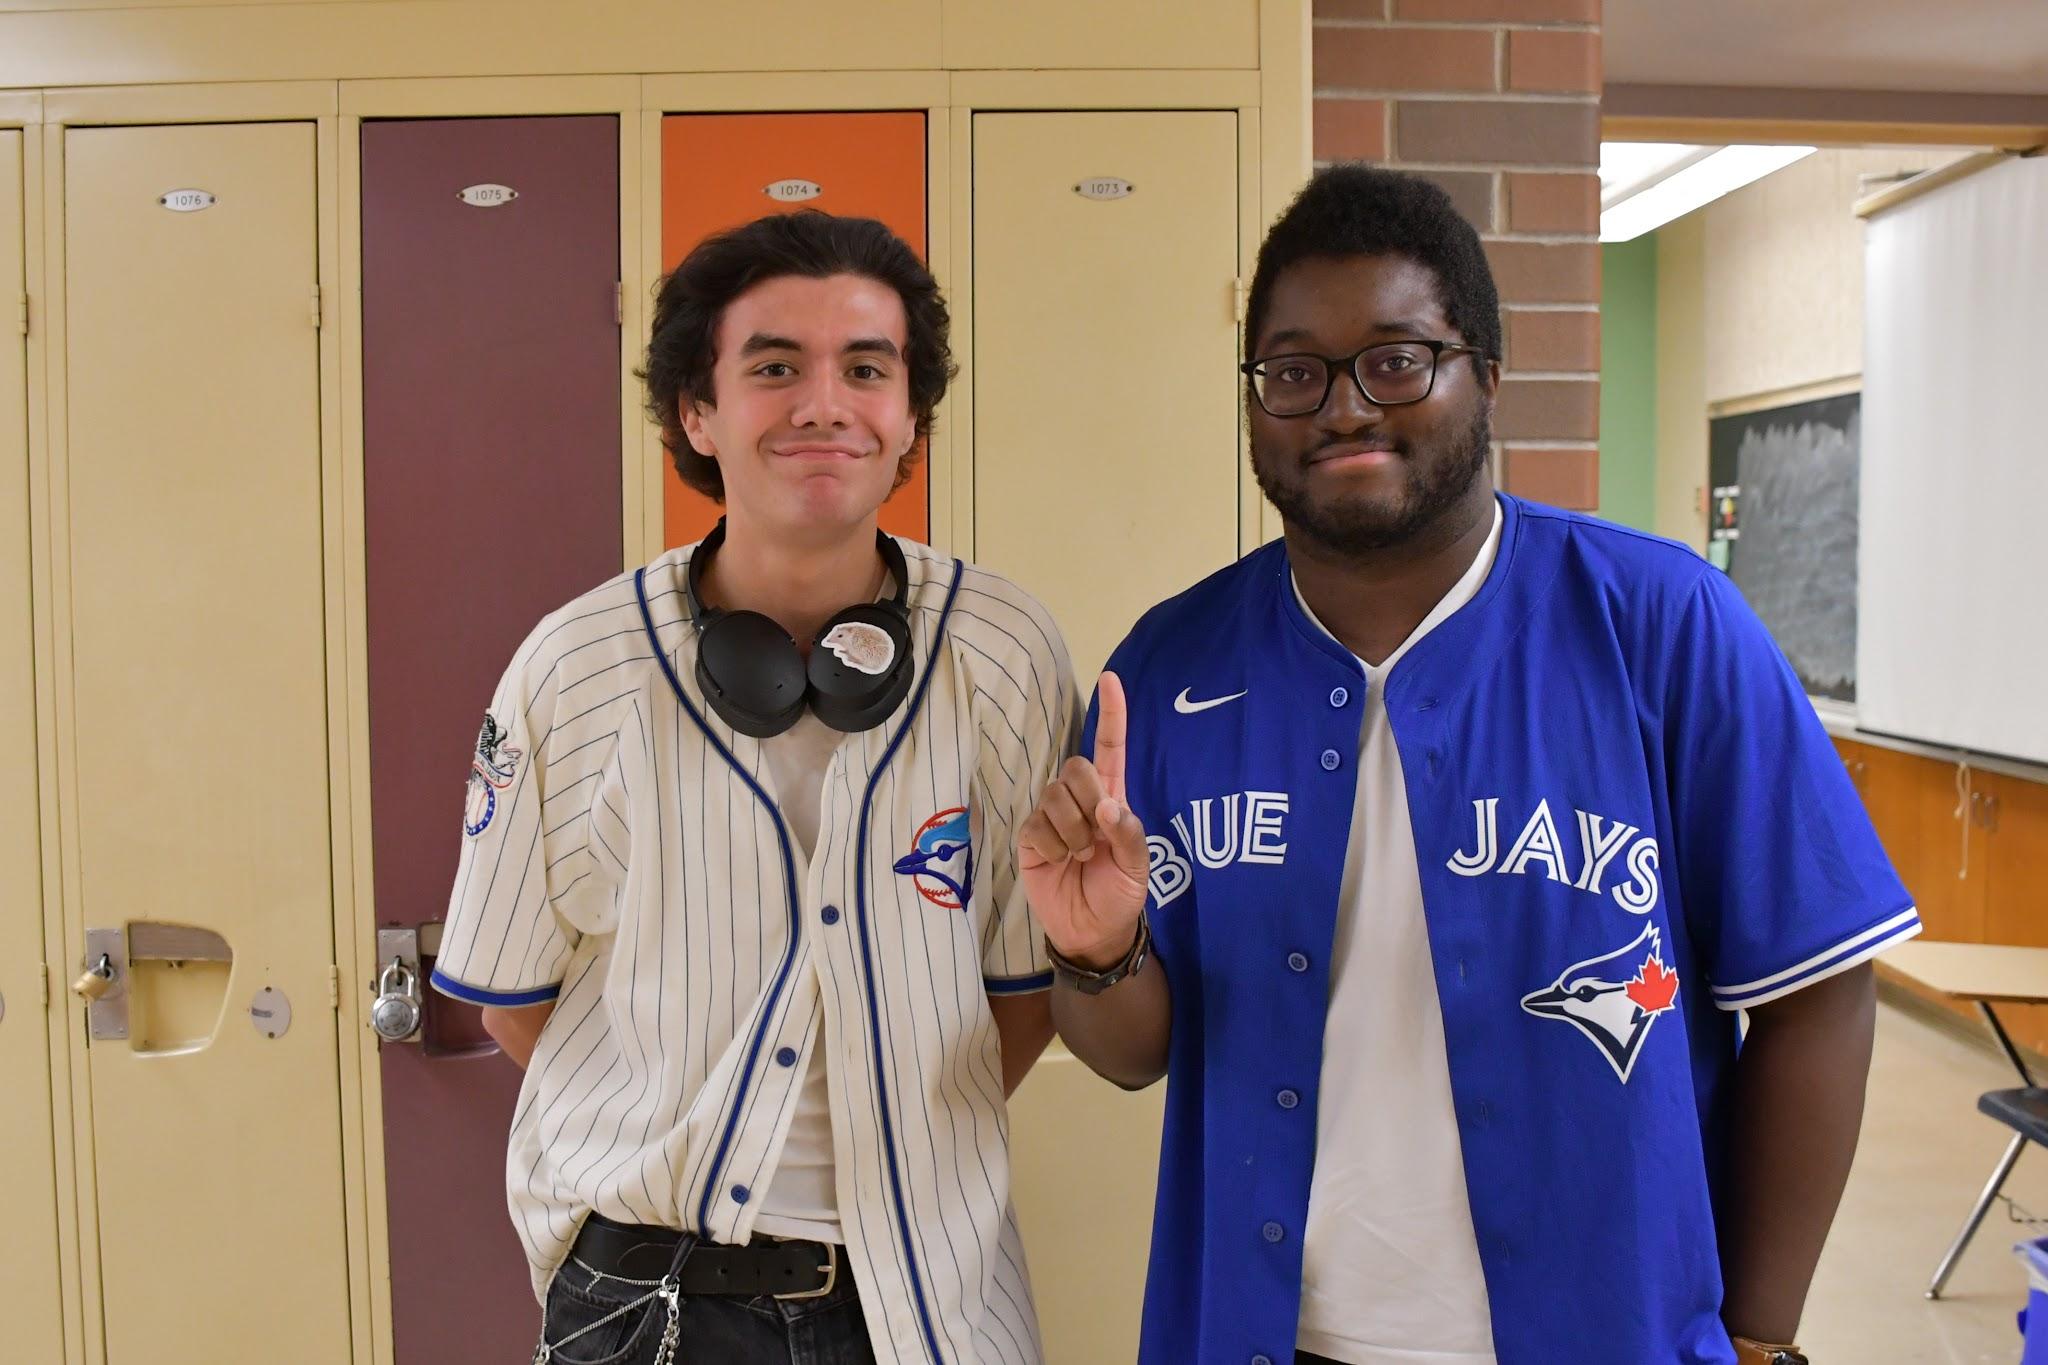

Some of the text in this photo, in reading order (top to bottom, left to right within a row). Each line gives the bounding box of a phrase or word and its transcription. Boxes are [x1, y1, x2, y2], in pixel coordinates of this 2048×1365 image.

[781, 184, 808, 196] 1074
[1091, 183, 1120, 194] 1073
[175, 194, 202, 206] 1076
[475, 189, 502, 201] 1075
[1446, 797, 1660, 915] JAYS
